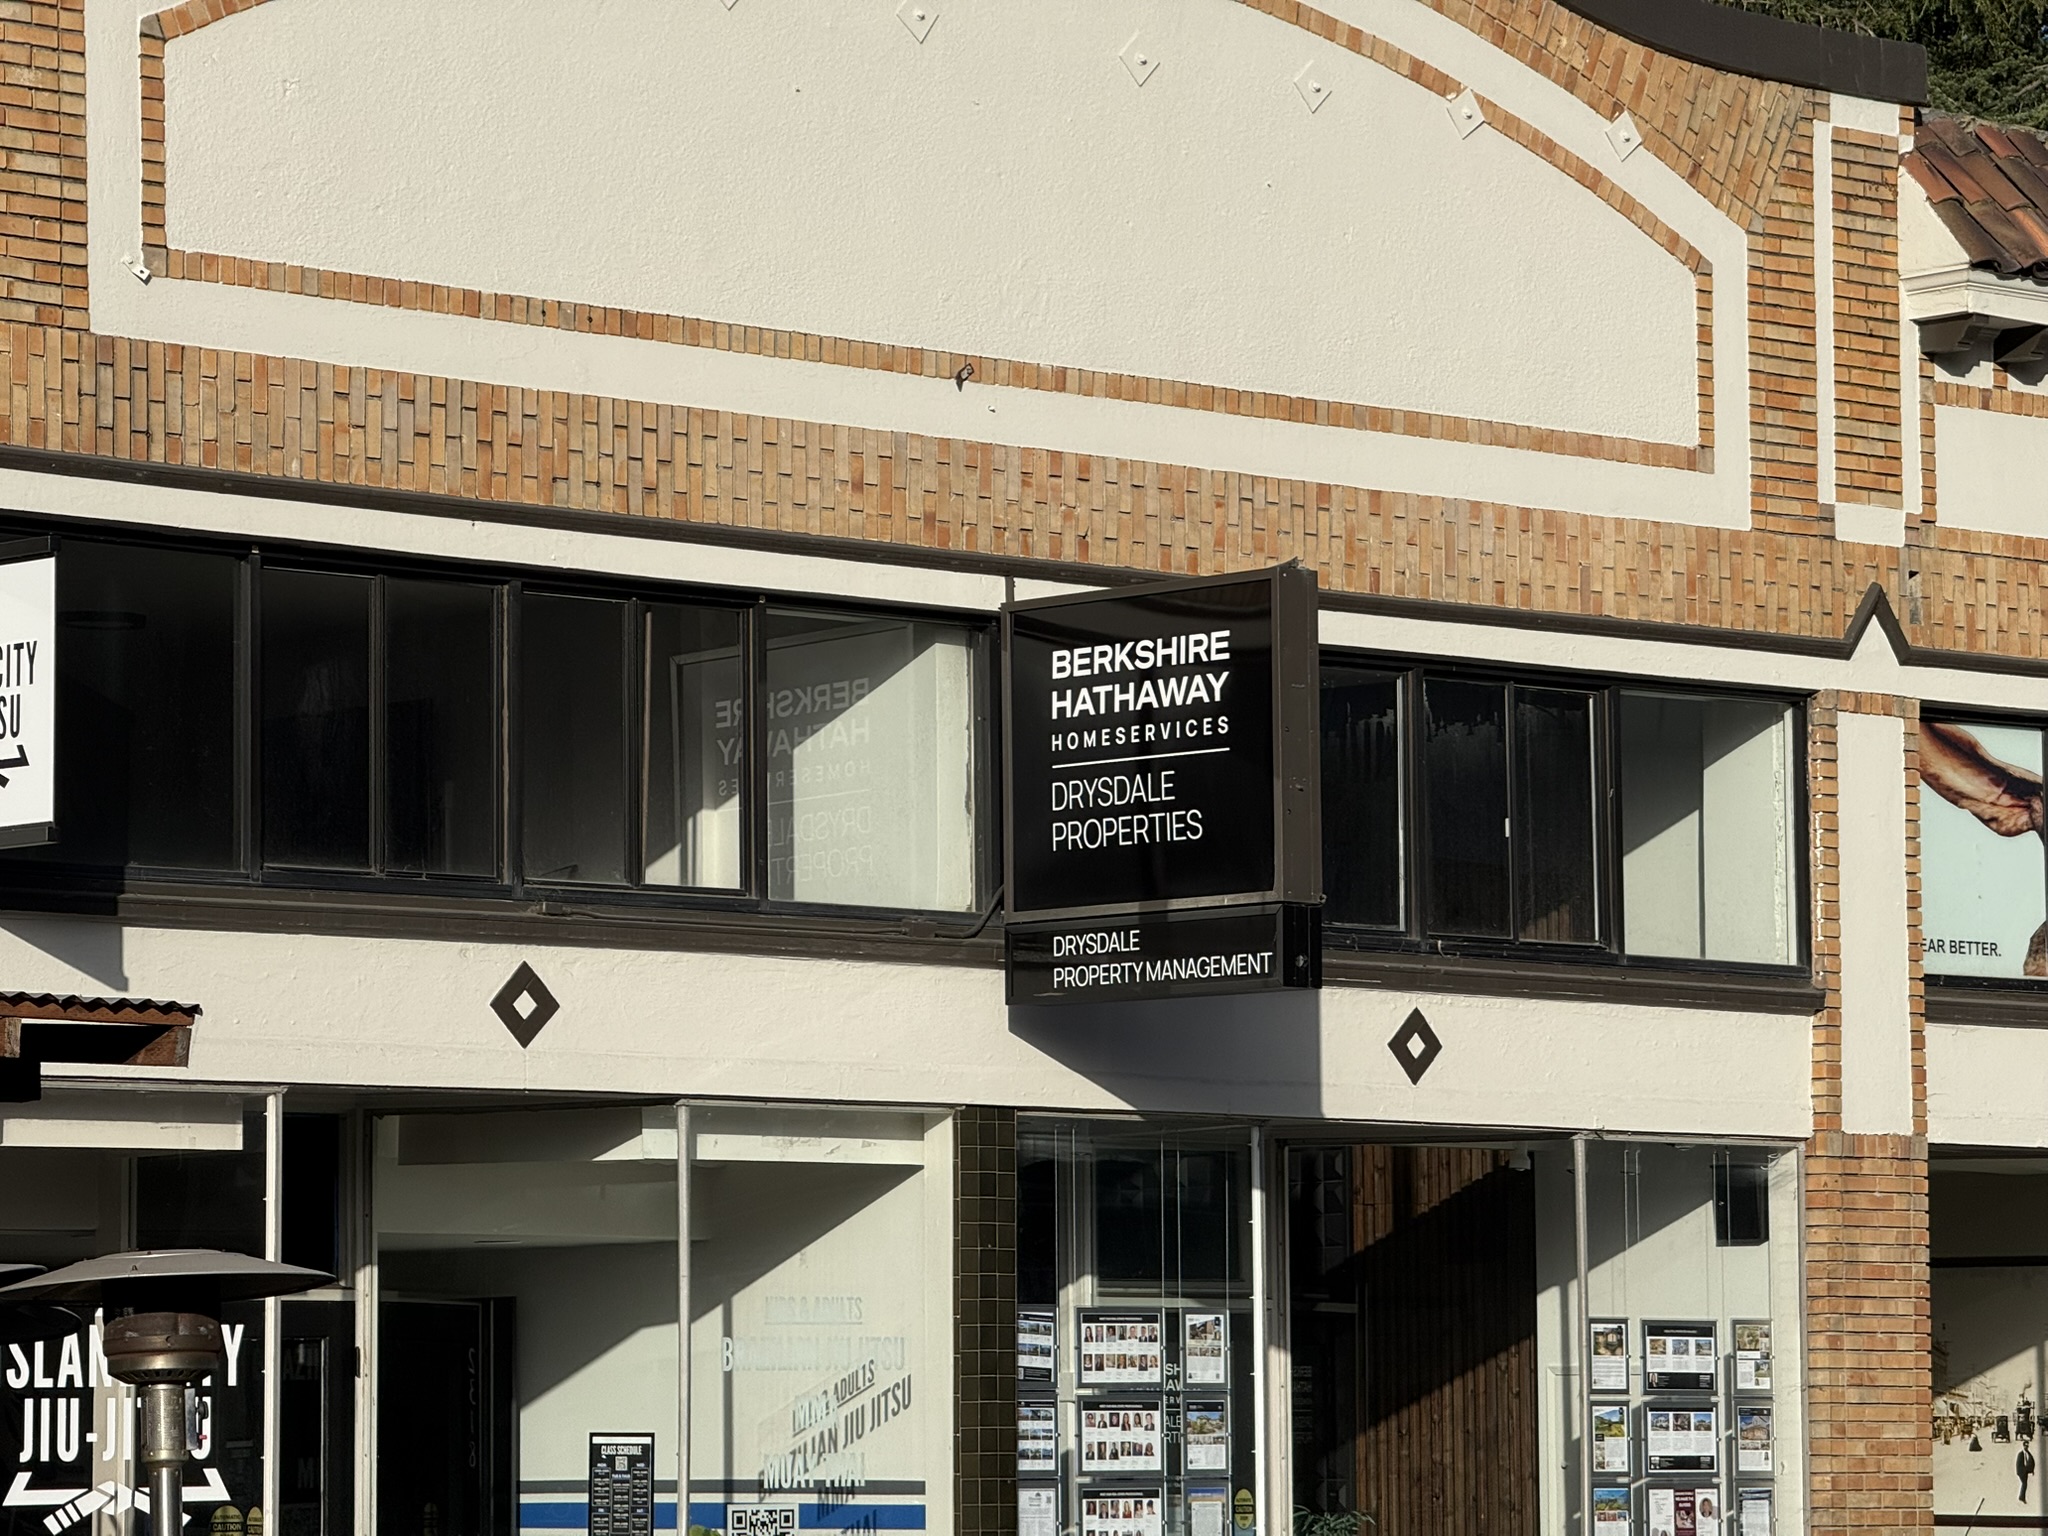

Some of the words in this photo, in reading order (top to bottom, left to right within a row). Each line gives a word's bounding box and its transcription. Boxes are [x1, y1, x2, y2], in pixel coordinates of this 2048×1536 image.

[1051, 629, 1231, 679] BERKSHIRE
[1051, 671, 1230, 720] HATHAWAY
[1051, 716, 1230, 752] HOMESERVICES
[1051, 771, 1176, 811] DRYSDALE
[1052, 809, 1204, 852] PROPERTIES
[1053, 929, 1141, 957] DRYSDALE
[1949, 939, 2002, 957] BETTER.
[1053, 961, 1146, 989] PROPERTY
[1146, 952, 1273, 982] MANAGEMENT
[843, 1404, 865, 1450] JIU
[869, 1374, 913, 1433] JITSU
[600, 1445, 616, 1455] CLASS
[212, 1523, 242, 1531] CAUTION
